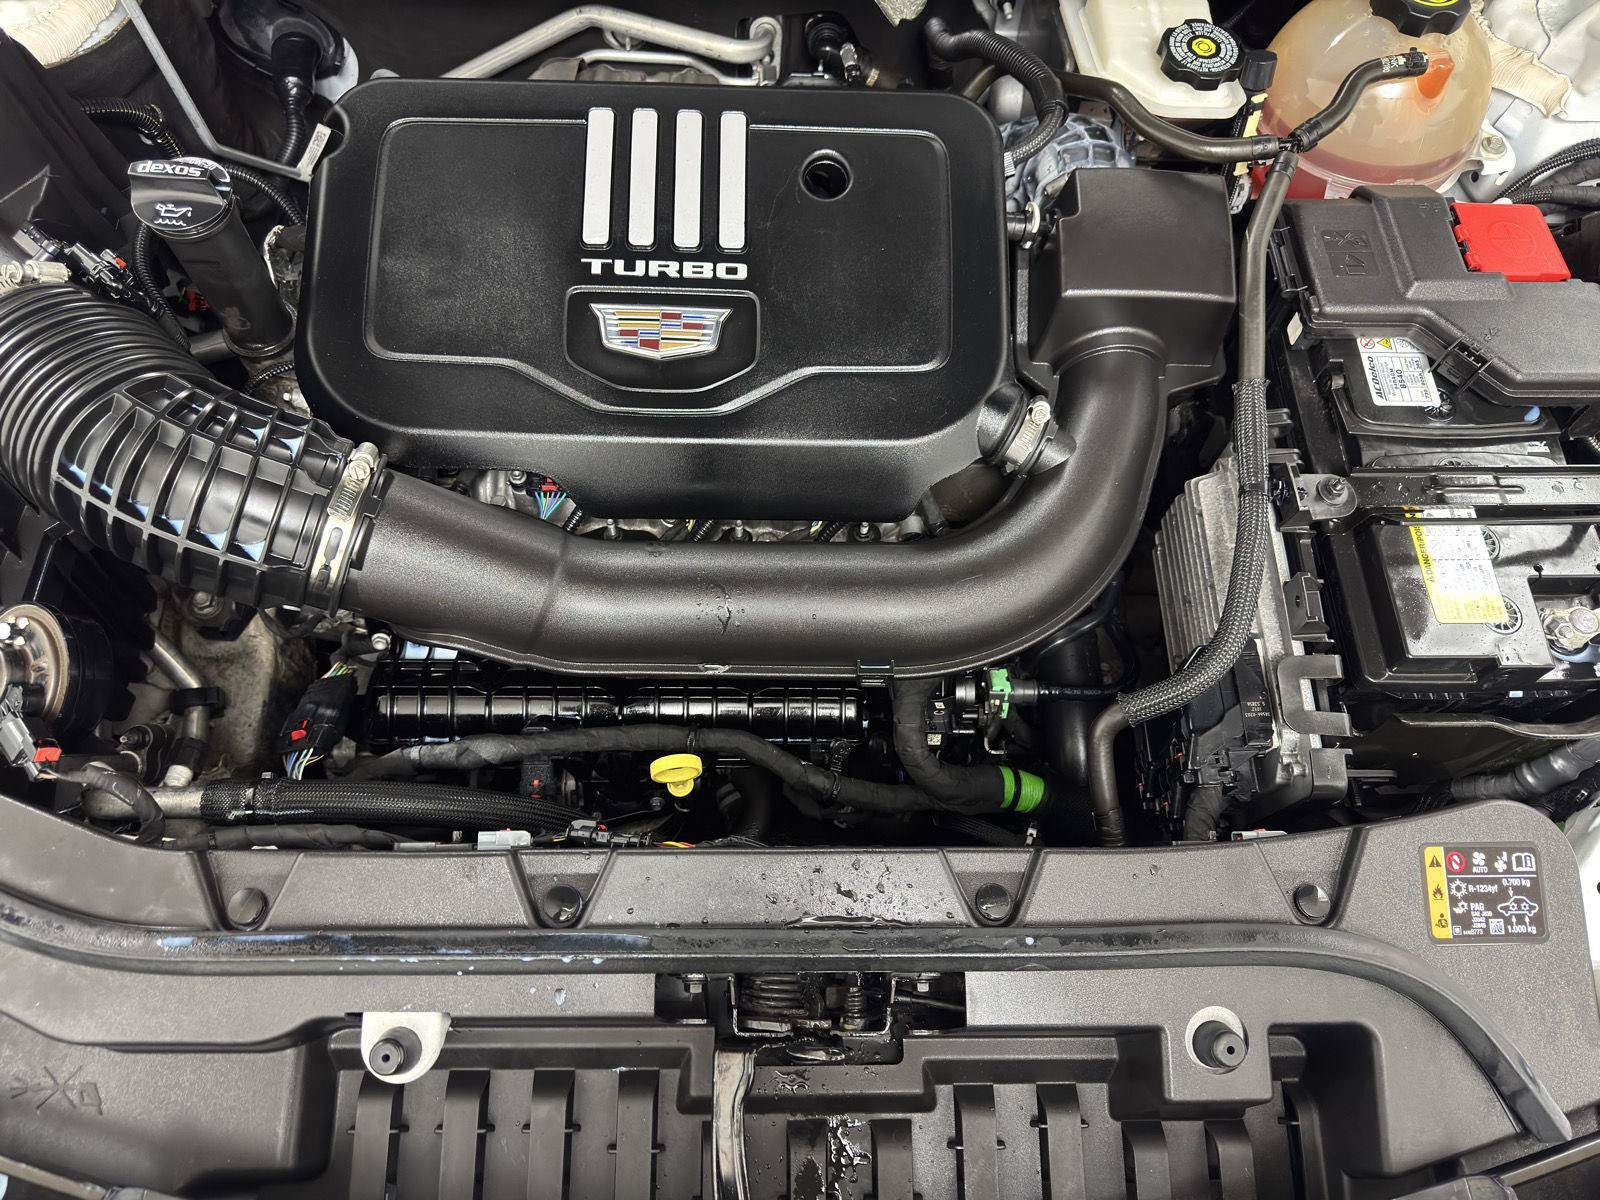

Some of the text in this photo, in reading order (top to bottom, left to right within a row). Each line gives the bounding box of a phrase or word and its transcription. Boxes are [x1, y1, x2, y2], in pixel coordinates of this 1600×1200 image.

[137, 160, 205, 177] dexos
[580, 258, 748, 280] TURBO
[1368, 356, 1384, 399] ACDelco
[1396, 369, 1407, 389] 8540
[1468, 885, 1498, 893] R-1234yf
[1502, 878, 1531, 887] 0.700 kg
[1470, 903, 1484, 911] PAG
[1507, 925, 1537, 934] 1.000 kg
